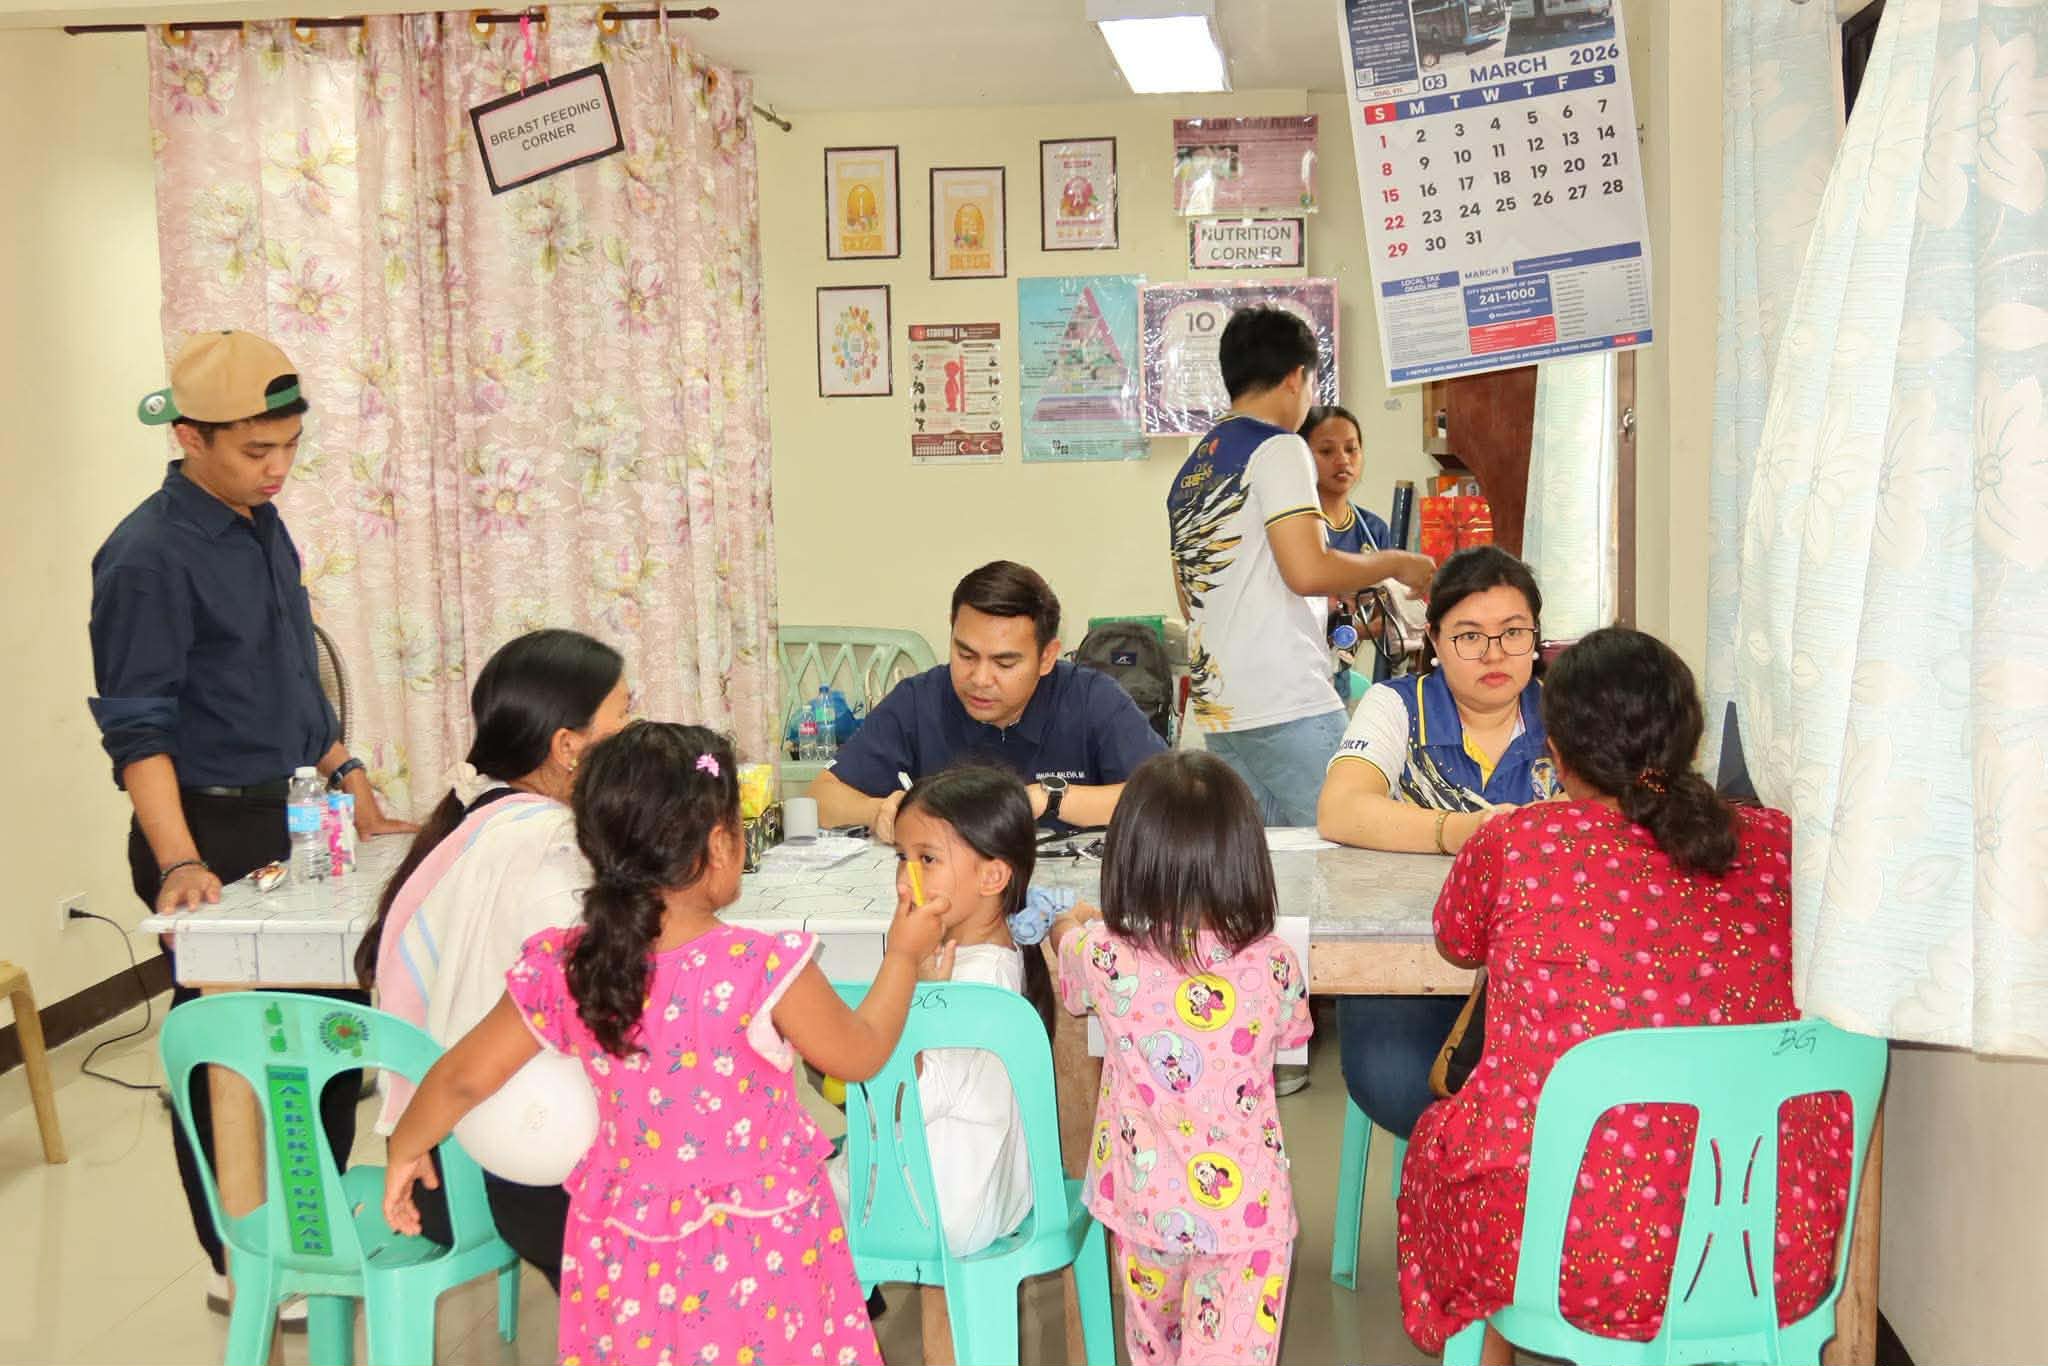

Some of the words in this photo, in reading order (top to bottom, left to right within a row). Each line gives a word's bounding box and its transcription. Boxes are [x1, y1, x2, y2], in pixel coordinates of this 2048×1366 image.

[1470, 56, 1547, 84] MARCH
[1569, 46, 1619, 66] 2026
[1375, 107, 1385, 120] S
[1409, 102, 1425, 115] M
[1450, 95, 1460, 108] T
[1482, 89, 1499, 103] W
[1523, 82, 1534, 95] T
[1557, 76, 1568, 90] F
[1594, 70, 1605, 83] S
[1426, 76, 1445, 90] 03
[490, 118, 540, 147] BREAST
[543, 98, 601, 127] FEEDING
[1380, 135, 1387, 149] 1
[1416, 130, 1426, 143] 2
[1455, 124, 1465, 137] 3
[1490, 117, 1501, 130] 4
[1527, 111, 1538, 124] 5
[1562, 105, 1573, 118] 6
[1598, 99, 1608, 113] 7
[522, 123, 576, 151] CORNER
[1382, 163, 1393, 176] 8
[1419, 157, 1430, 170] 9
[1454, 150, 1472, 164] 10
[1492, 144, 1506, 157] 11
[1527, 138, 1544, 152] 12
[1562, 132, 1579, 145] 13
[1597, 126, 1615, 140] 14
[1383, 189, 1399, 203] 15
[1420, 184, 1437, 198] 16
[1458, 177, 1474, 191] 17
[1493, 171, 1511, 185] 18
[1531, 165, 1548, 178] 19
[1563, 158, 1585, 172] 20
[1601, 152, 1618, 166] 21
[1384, 215, 1405, 230] 22
[1422, 210, 1443, 224] 23
[1459, 204, 1481, 218] 24
[1495, 198, 1517, 212] 25
[1532, 192, 1554, 207] 26
[1568, 185, 1587, 199] 27
[1602, 180, 1623, 195] 28
[1201, 226, 1292, 241] NUTRITION
[1388, 242, 1409, 258] 29
[1425, 236, 1446, 251] 30
[1465, 230, 1483, 245] 31
[1211, 245, 1282, 260] CORNER
[1401, 277, 1425, 287] LOCAL
[1480, 287, 1536, 305] 241-1000
[1186, 311, 1216, 333] 10
